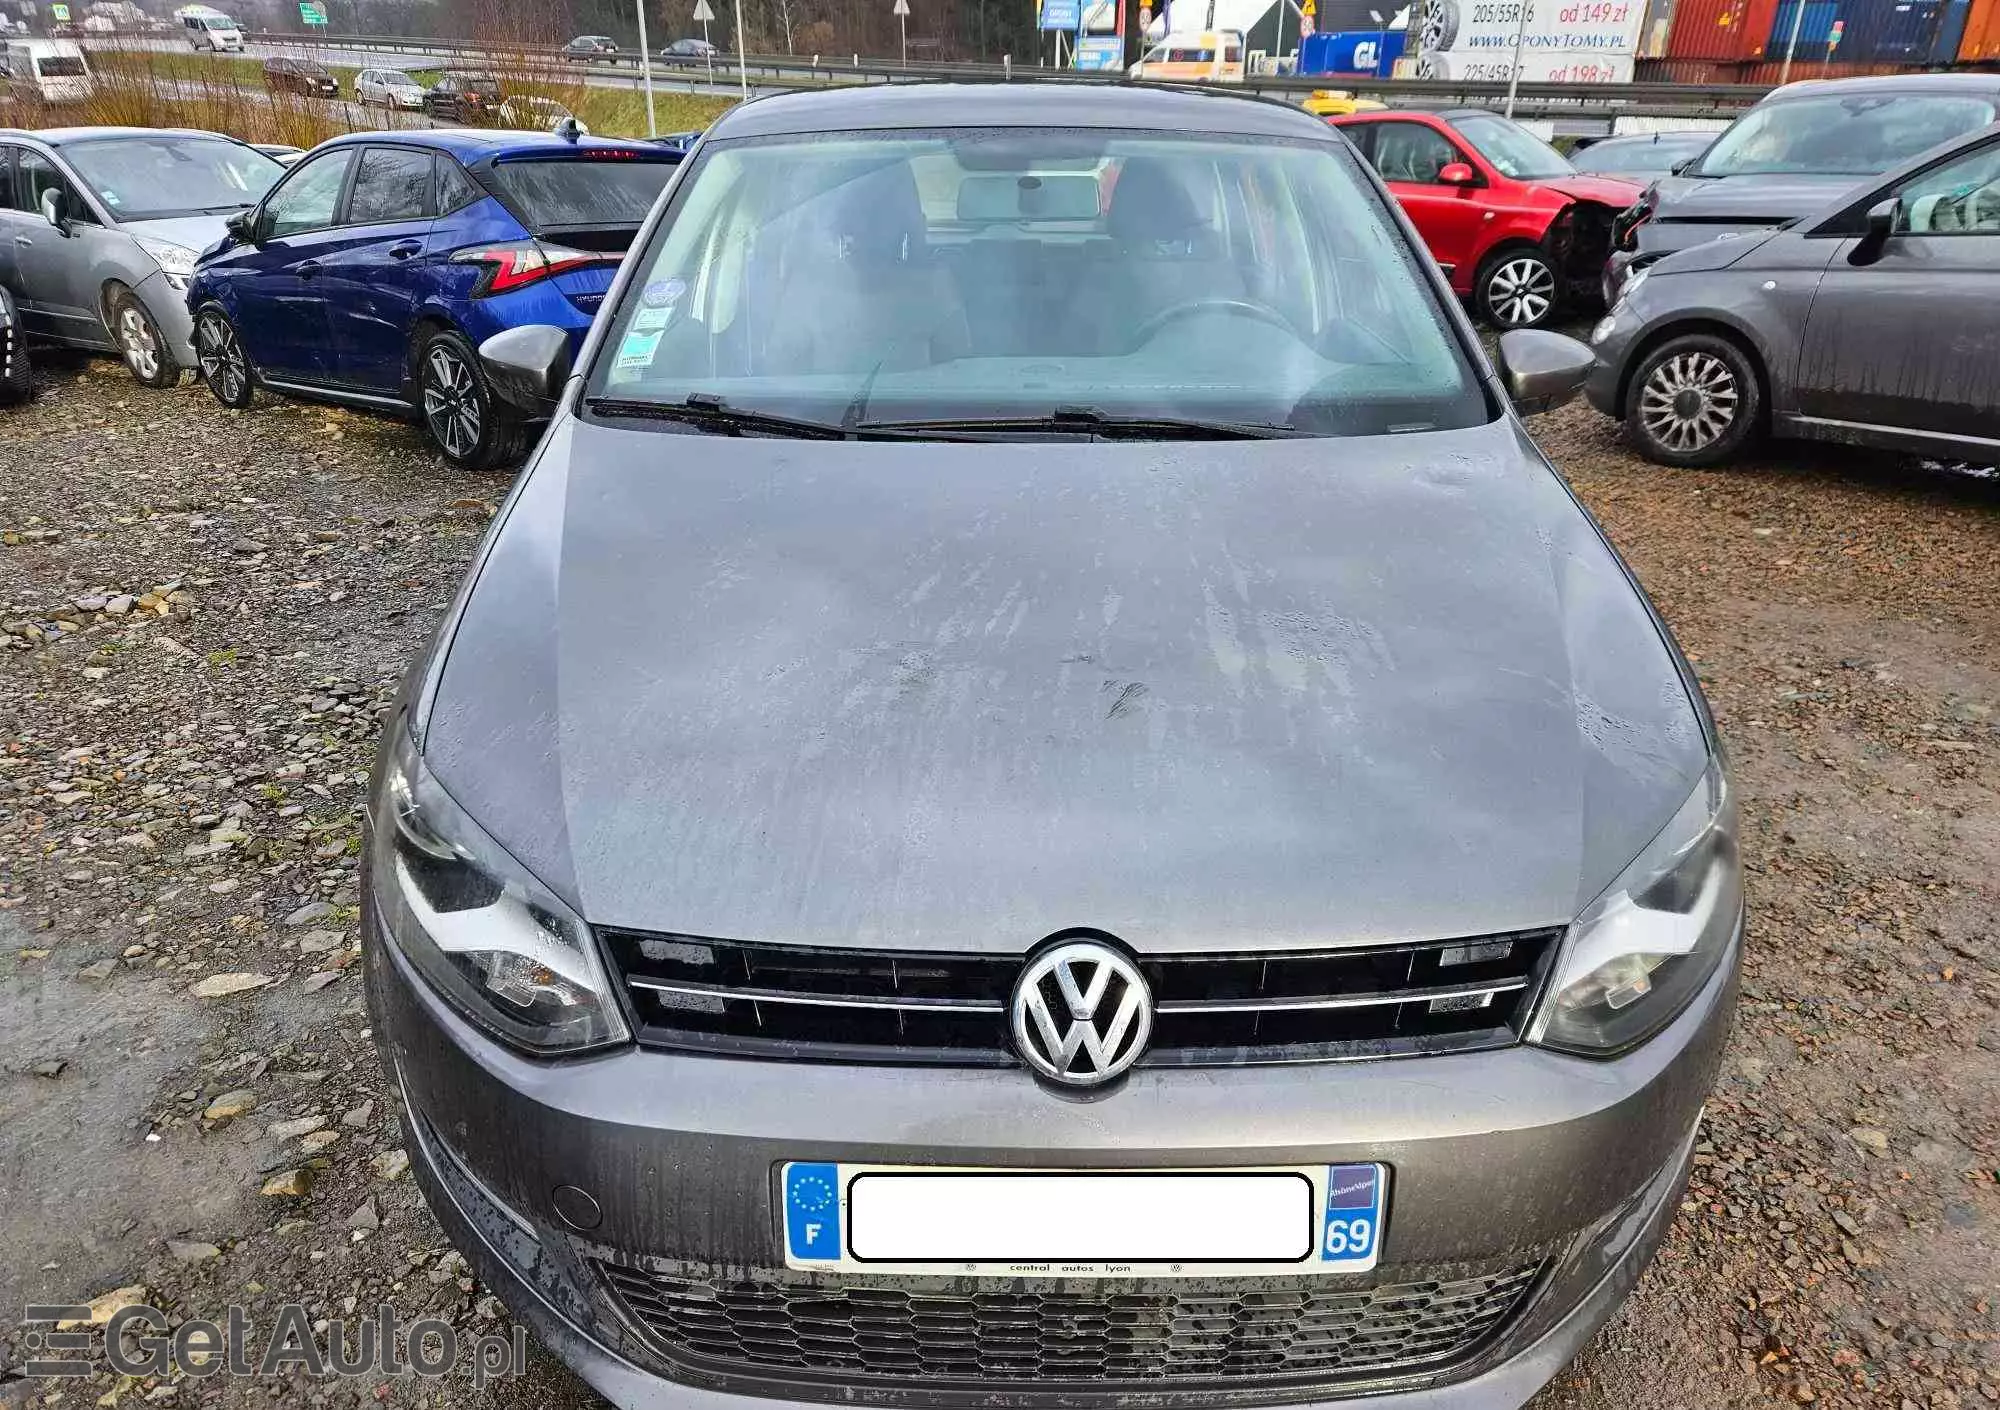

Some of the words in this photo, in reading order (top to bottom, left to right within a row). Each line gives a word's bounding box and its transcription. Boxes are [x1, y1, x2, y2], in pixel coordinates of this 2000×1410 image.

[1559, 4, 1579, 22] od
[1582, 3, 1611, 22] 149
[1613, 3, 1628, 22] zł
[1549, 64, 1568, 82] od
[1572, 64, 1599, 82] 198
[806, 1223, 822, 1245] F
[1326, 1219, 1371, 1254] 69
[1010, 1263, 1050, 1272] central
[1061, 1264, 1094, 1272] autos
[1105, 1263, 1131, 1273] lyon
